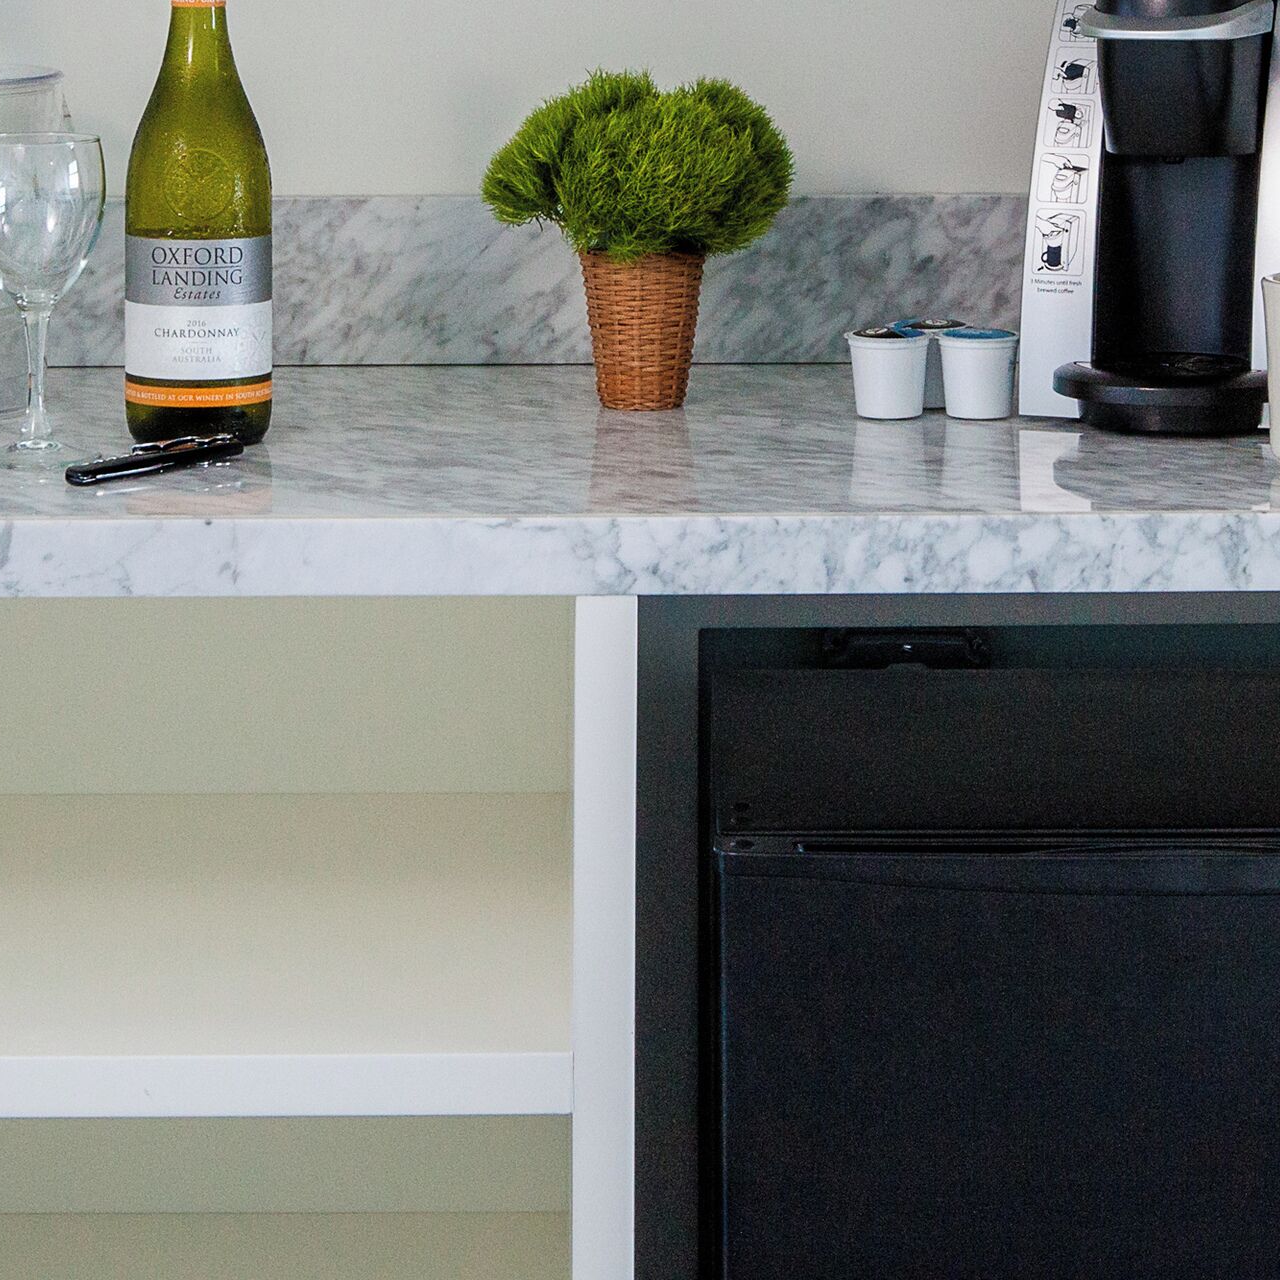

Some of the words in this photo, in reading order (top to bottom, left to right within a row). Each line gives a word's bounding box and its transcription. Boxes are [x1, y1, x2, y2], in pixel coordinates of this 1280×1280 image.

[152, 246, 243, 265] OXFORD
[152, 269, 242, 286] LANDING
[174, 287, 221, 300] Estates
[154, 328, 240, 338] CHARDONNAY
[181, 347, 212, 355] SOUTH
[141, 391, 166, 401] BOTTLED
[235, 391, 255, 400] SOUTH
